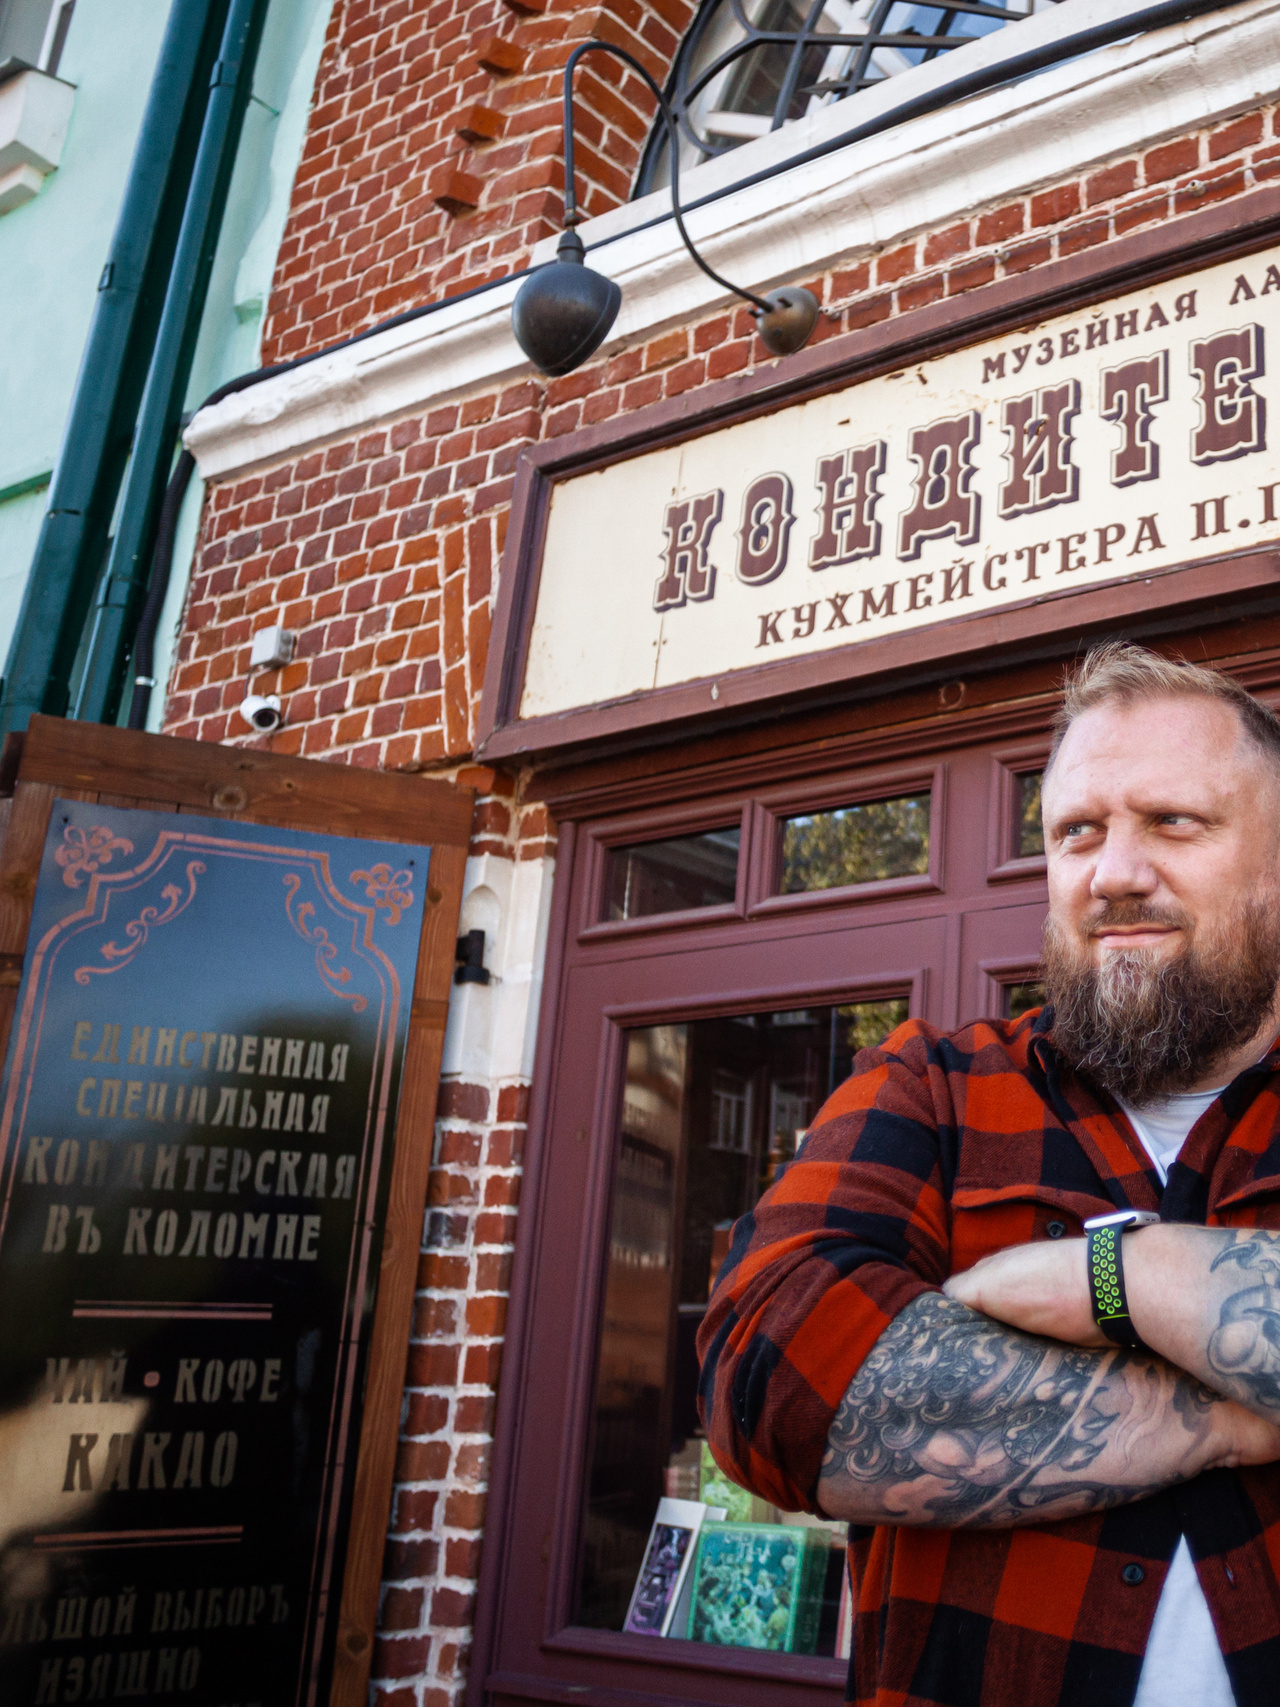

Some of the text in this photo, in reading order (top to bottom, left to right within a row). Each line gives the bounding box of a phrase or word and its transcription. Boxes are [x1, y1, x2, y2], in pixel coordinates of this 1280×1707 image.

[981, 289, 1199, 384] МУЗЕЙНАЯ
[755, 513, 1167, 648] КУХМЕЙСТЕРА
[70, 1020, 350, 1082] ЕДИНСТВЕННАЯ
[22, 1136, 356, 1199] КОНДИТЕРСКАЯ
[42, 1204, 322, 1261] ВЪ КОЛОМНЕ
[173, 1358, 282, 1403] КОФЕ
[61, 1430, 239, 1491] КАКАО
[0, 1583, 291, 1646] ЛЬШОЙ ВЫБОРЪ
